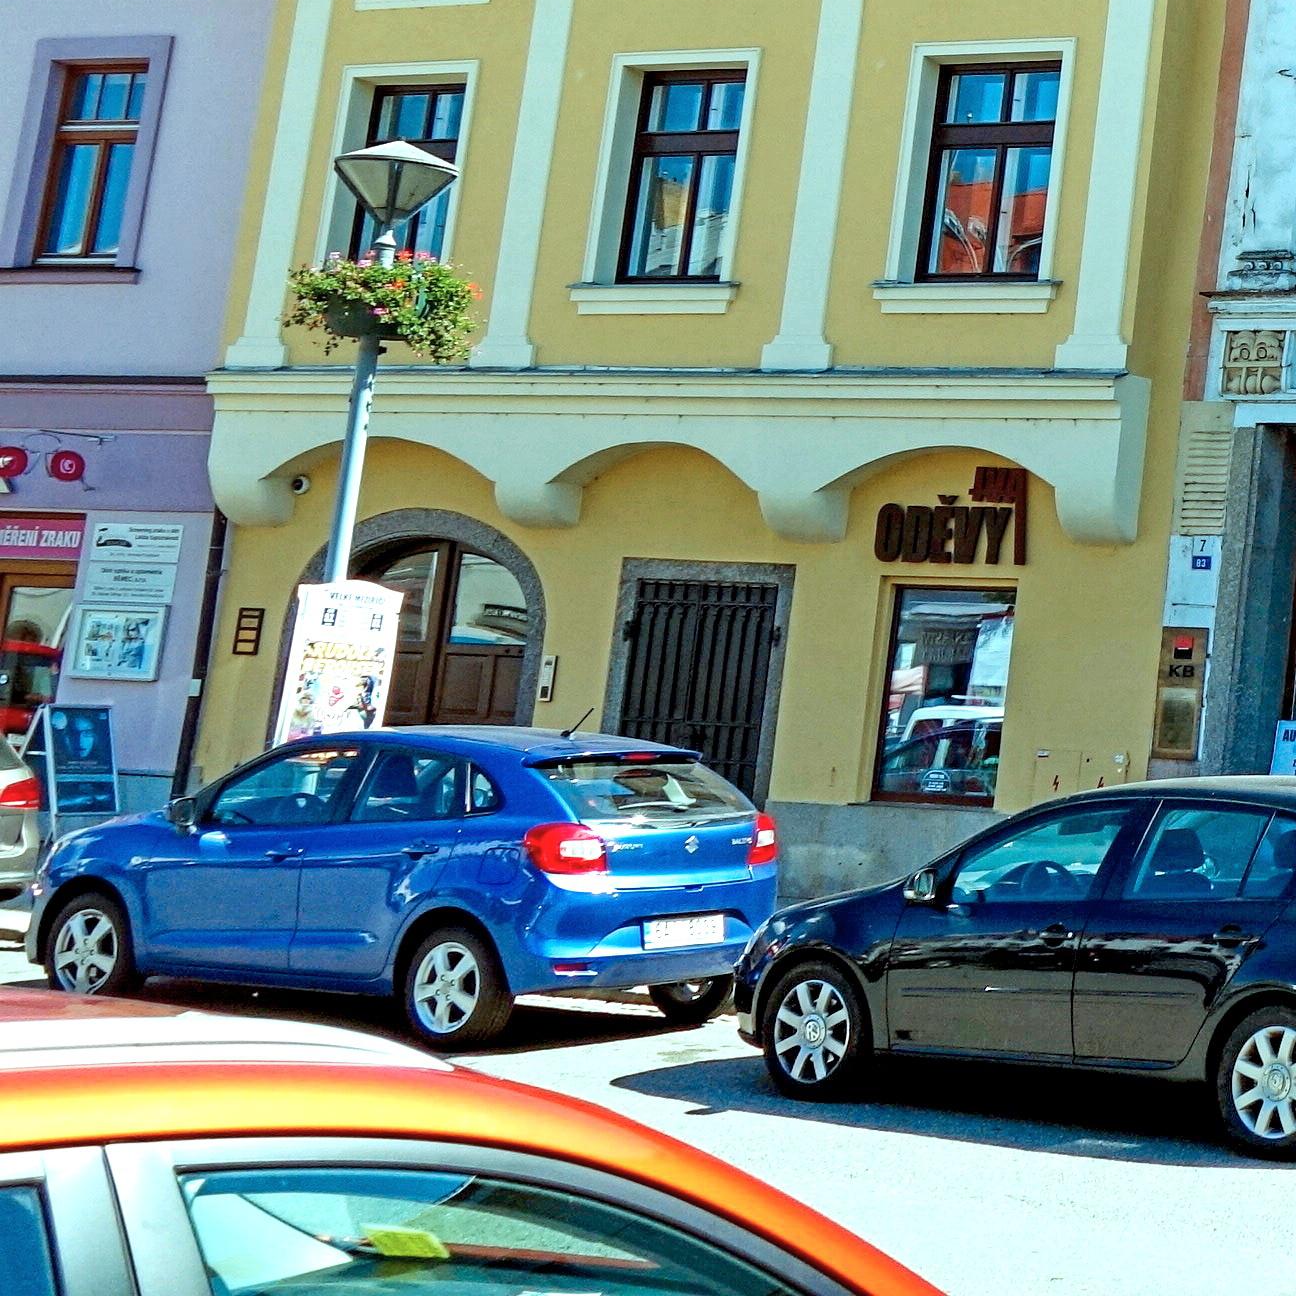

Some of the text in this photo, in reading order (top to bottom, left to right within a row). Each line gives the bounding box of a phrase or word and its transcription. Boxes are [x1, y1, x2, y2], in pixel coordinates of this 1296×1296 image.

[874, 495, 1012, 565] ODĚVY
[39, 530, 81, 548] ZRAKU
[1200, 539, 1206, 552] 7
[1196, 558, 1206, 568] 83
[1168, 665, 1195, 677] KB
